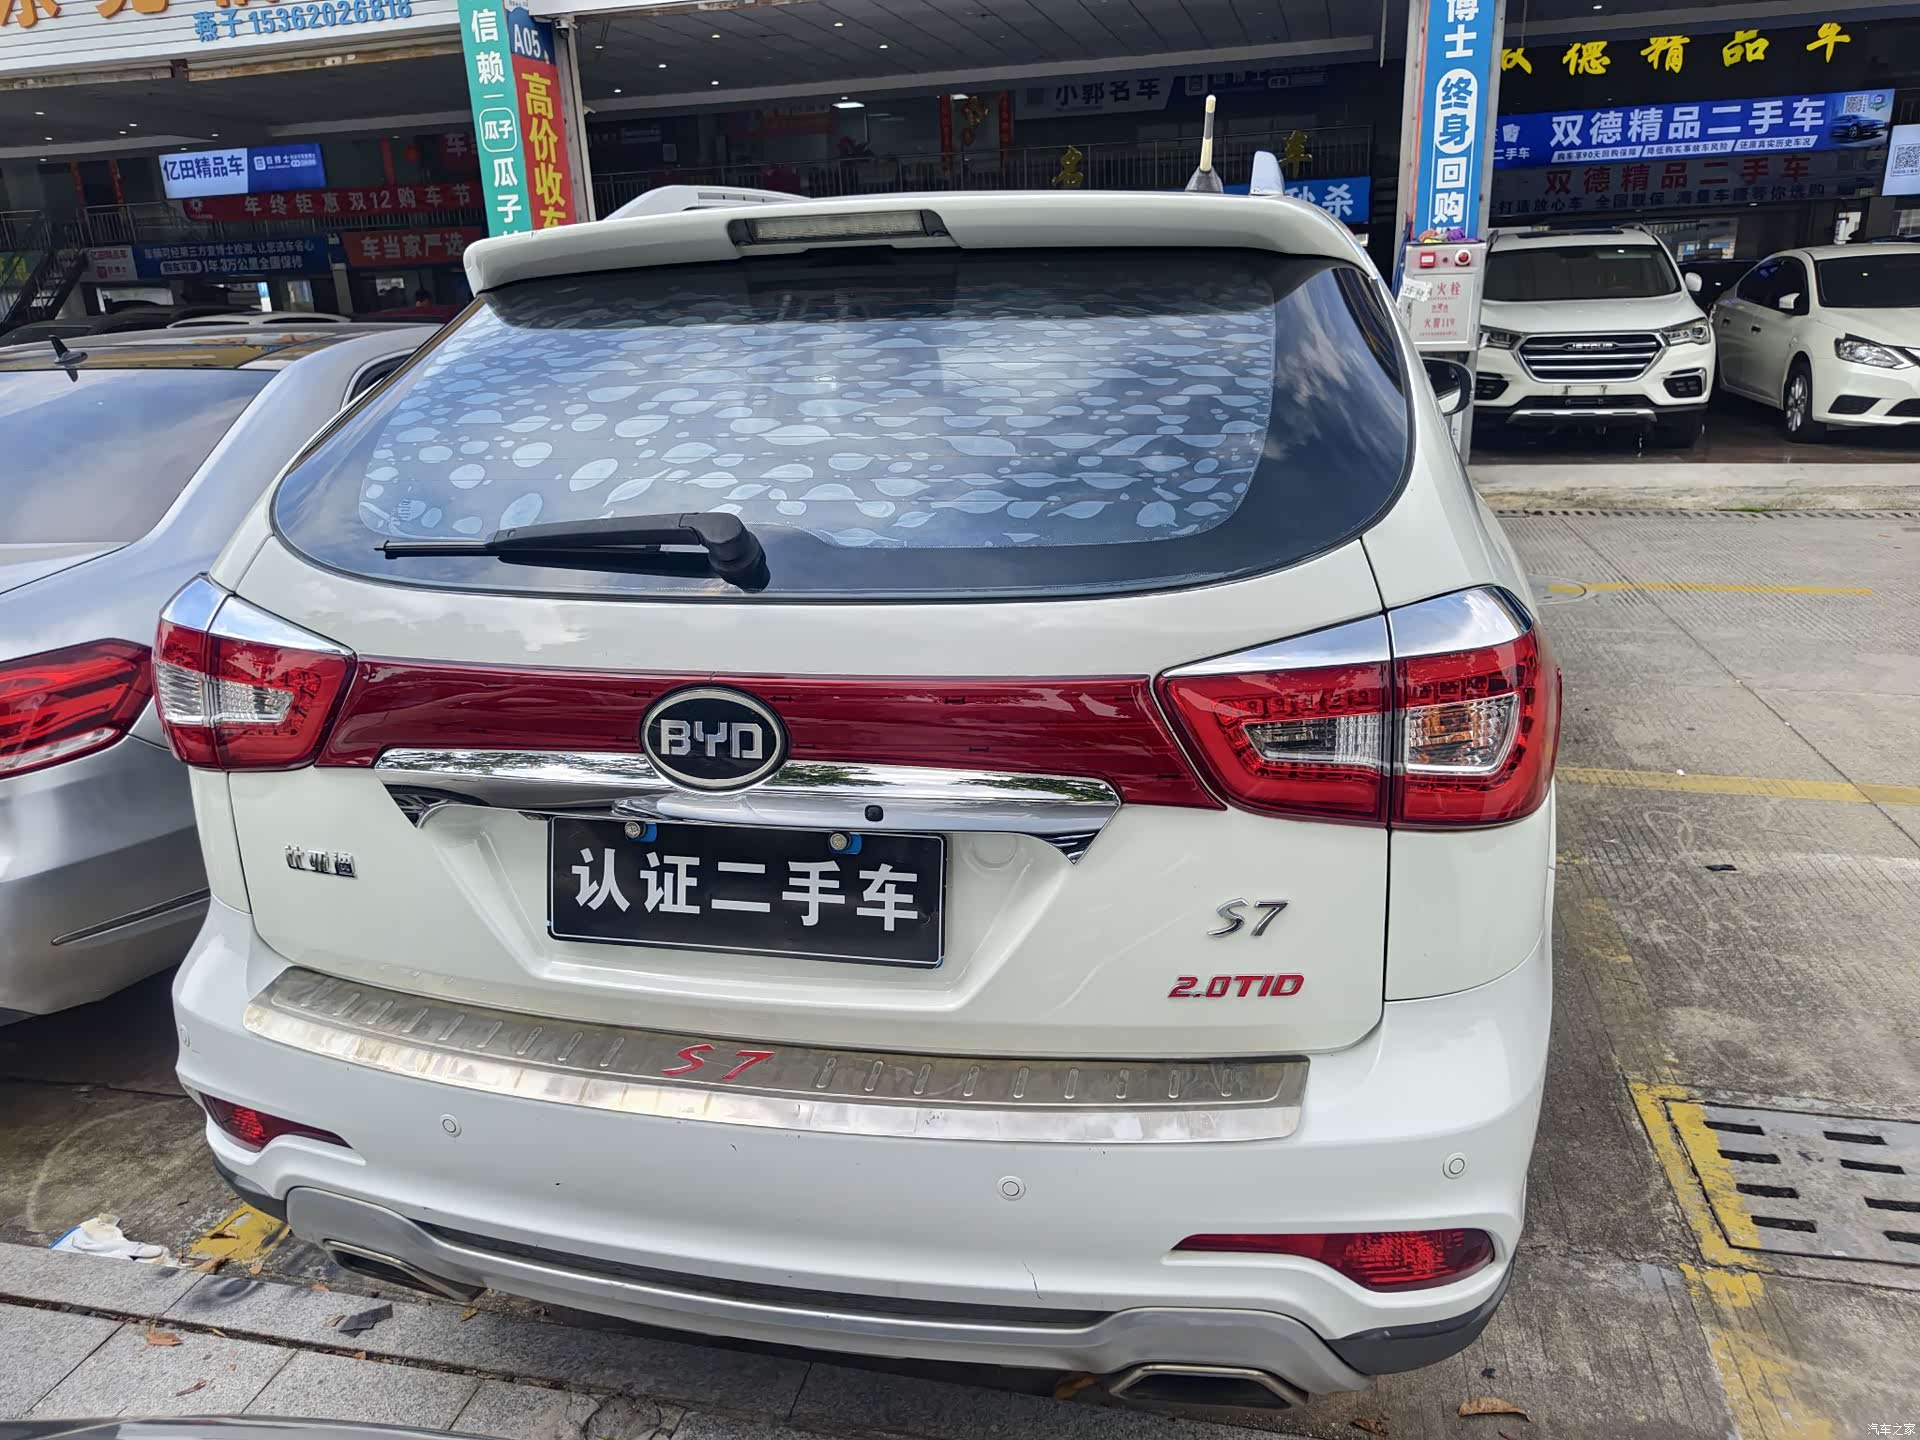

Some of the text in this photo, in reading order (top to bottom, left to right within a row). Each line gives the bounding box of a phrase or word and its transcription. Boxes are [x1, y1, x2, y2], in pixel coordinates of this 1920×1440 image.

[193, 8, 241, 42] 燕子
[250, 0, 412, 35] 15362026818
[514, 23, 541, 58] A05
[485, 119, 513, 140] 瓜子
[1550, 97, 1825, 147] 双德精品二手车
[445, 134, 476, 156] 车
[163, 155, 245, 181] 亿田精品车
[1545, 157, 1810, 194] 双德精品二手车
[493, 157, 522, 237] 瓜子
[361, 232, 465, 260] 车当家严选
[660, 719, 763, 760] BYD
[571, 847, 919, 932] 认证二手车
[1206, 897, 1290, 938] S7
[1168, 973, 1305, 999] 2.0TID
